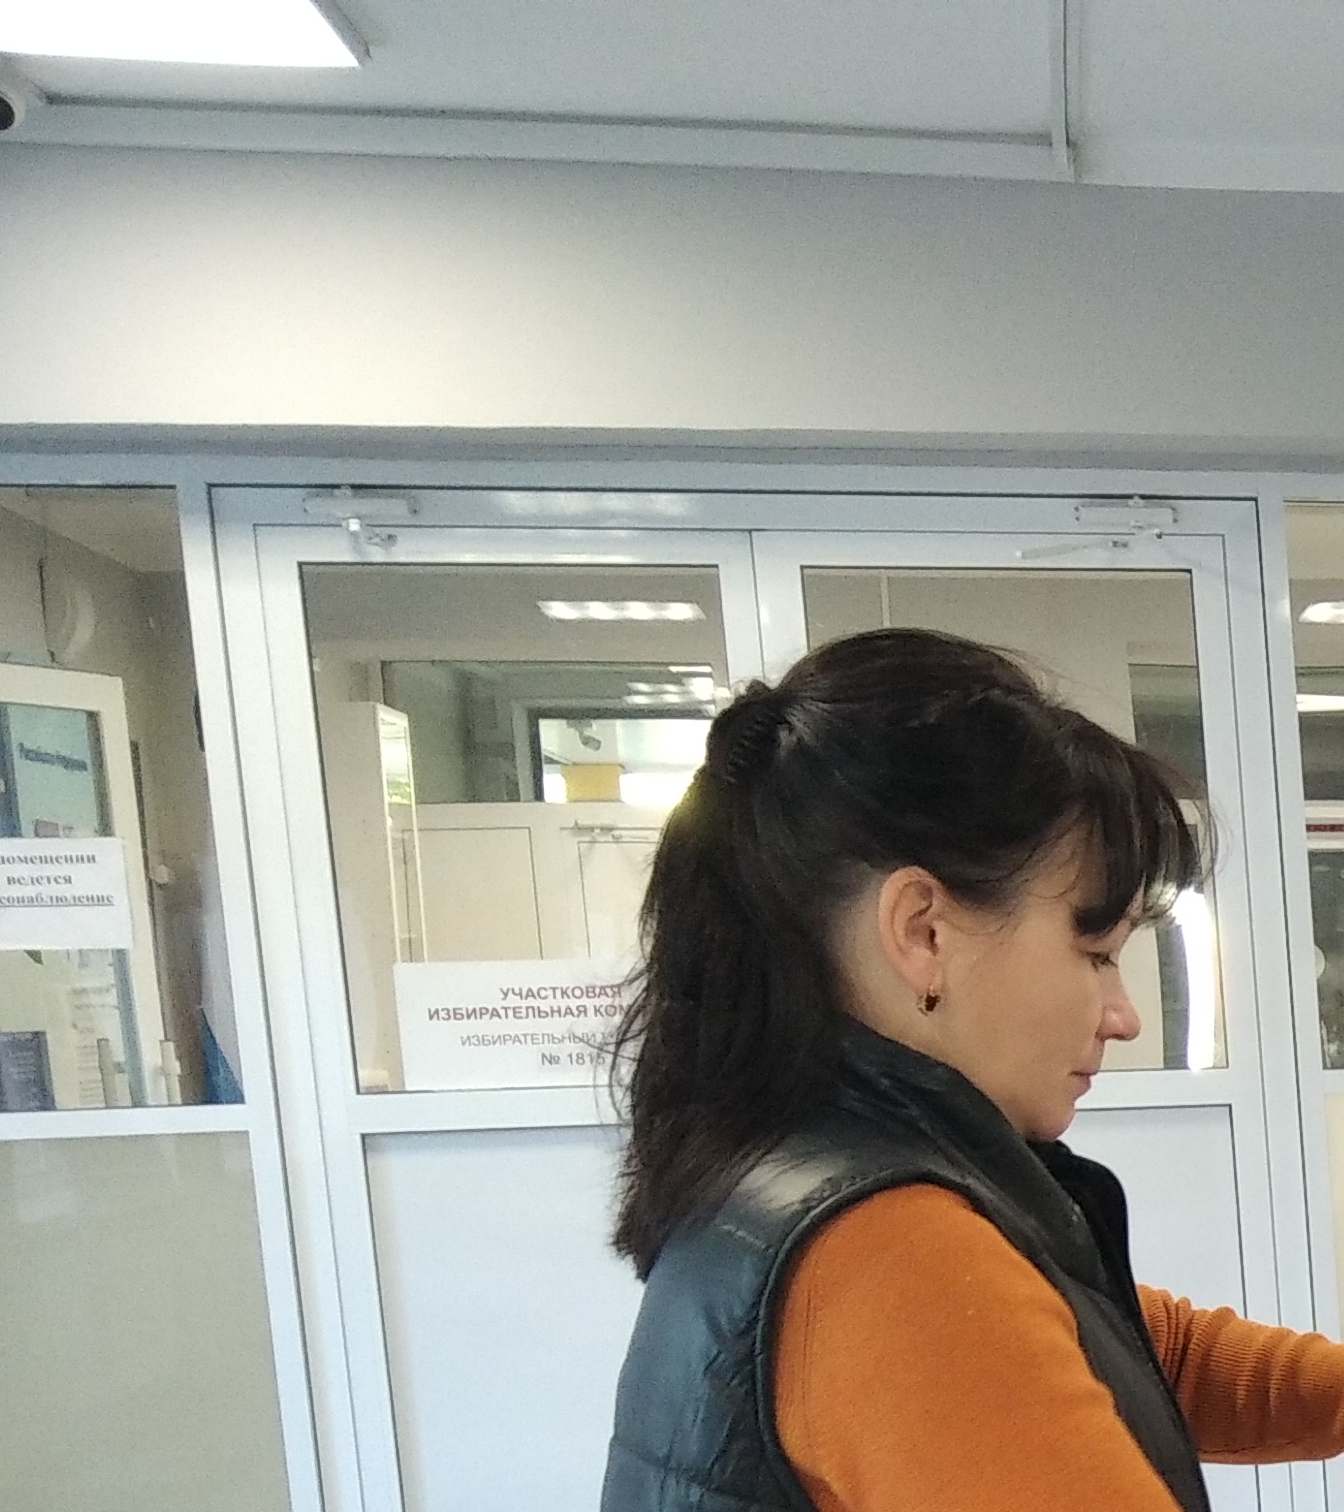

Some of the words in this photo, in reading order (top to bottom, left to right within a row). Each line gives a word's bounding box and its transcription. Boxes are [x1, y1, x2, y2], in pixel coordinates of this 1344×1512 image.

[499, 985, 622, 1001] УЧАСТКОВАЯ
[427, 1004, 588, 1021] ИЗБИРАТЕЛЬНАЯ
[460, 1032, 597, 1047] ИЗБИРАТЕЛЬНЫЙ
[541, 1052, 561, 1066] №
[567, 1051, 606, 1066] 1815
